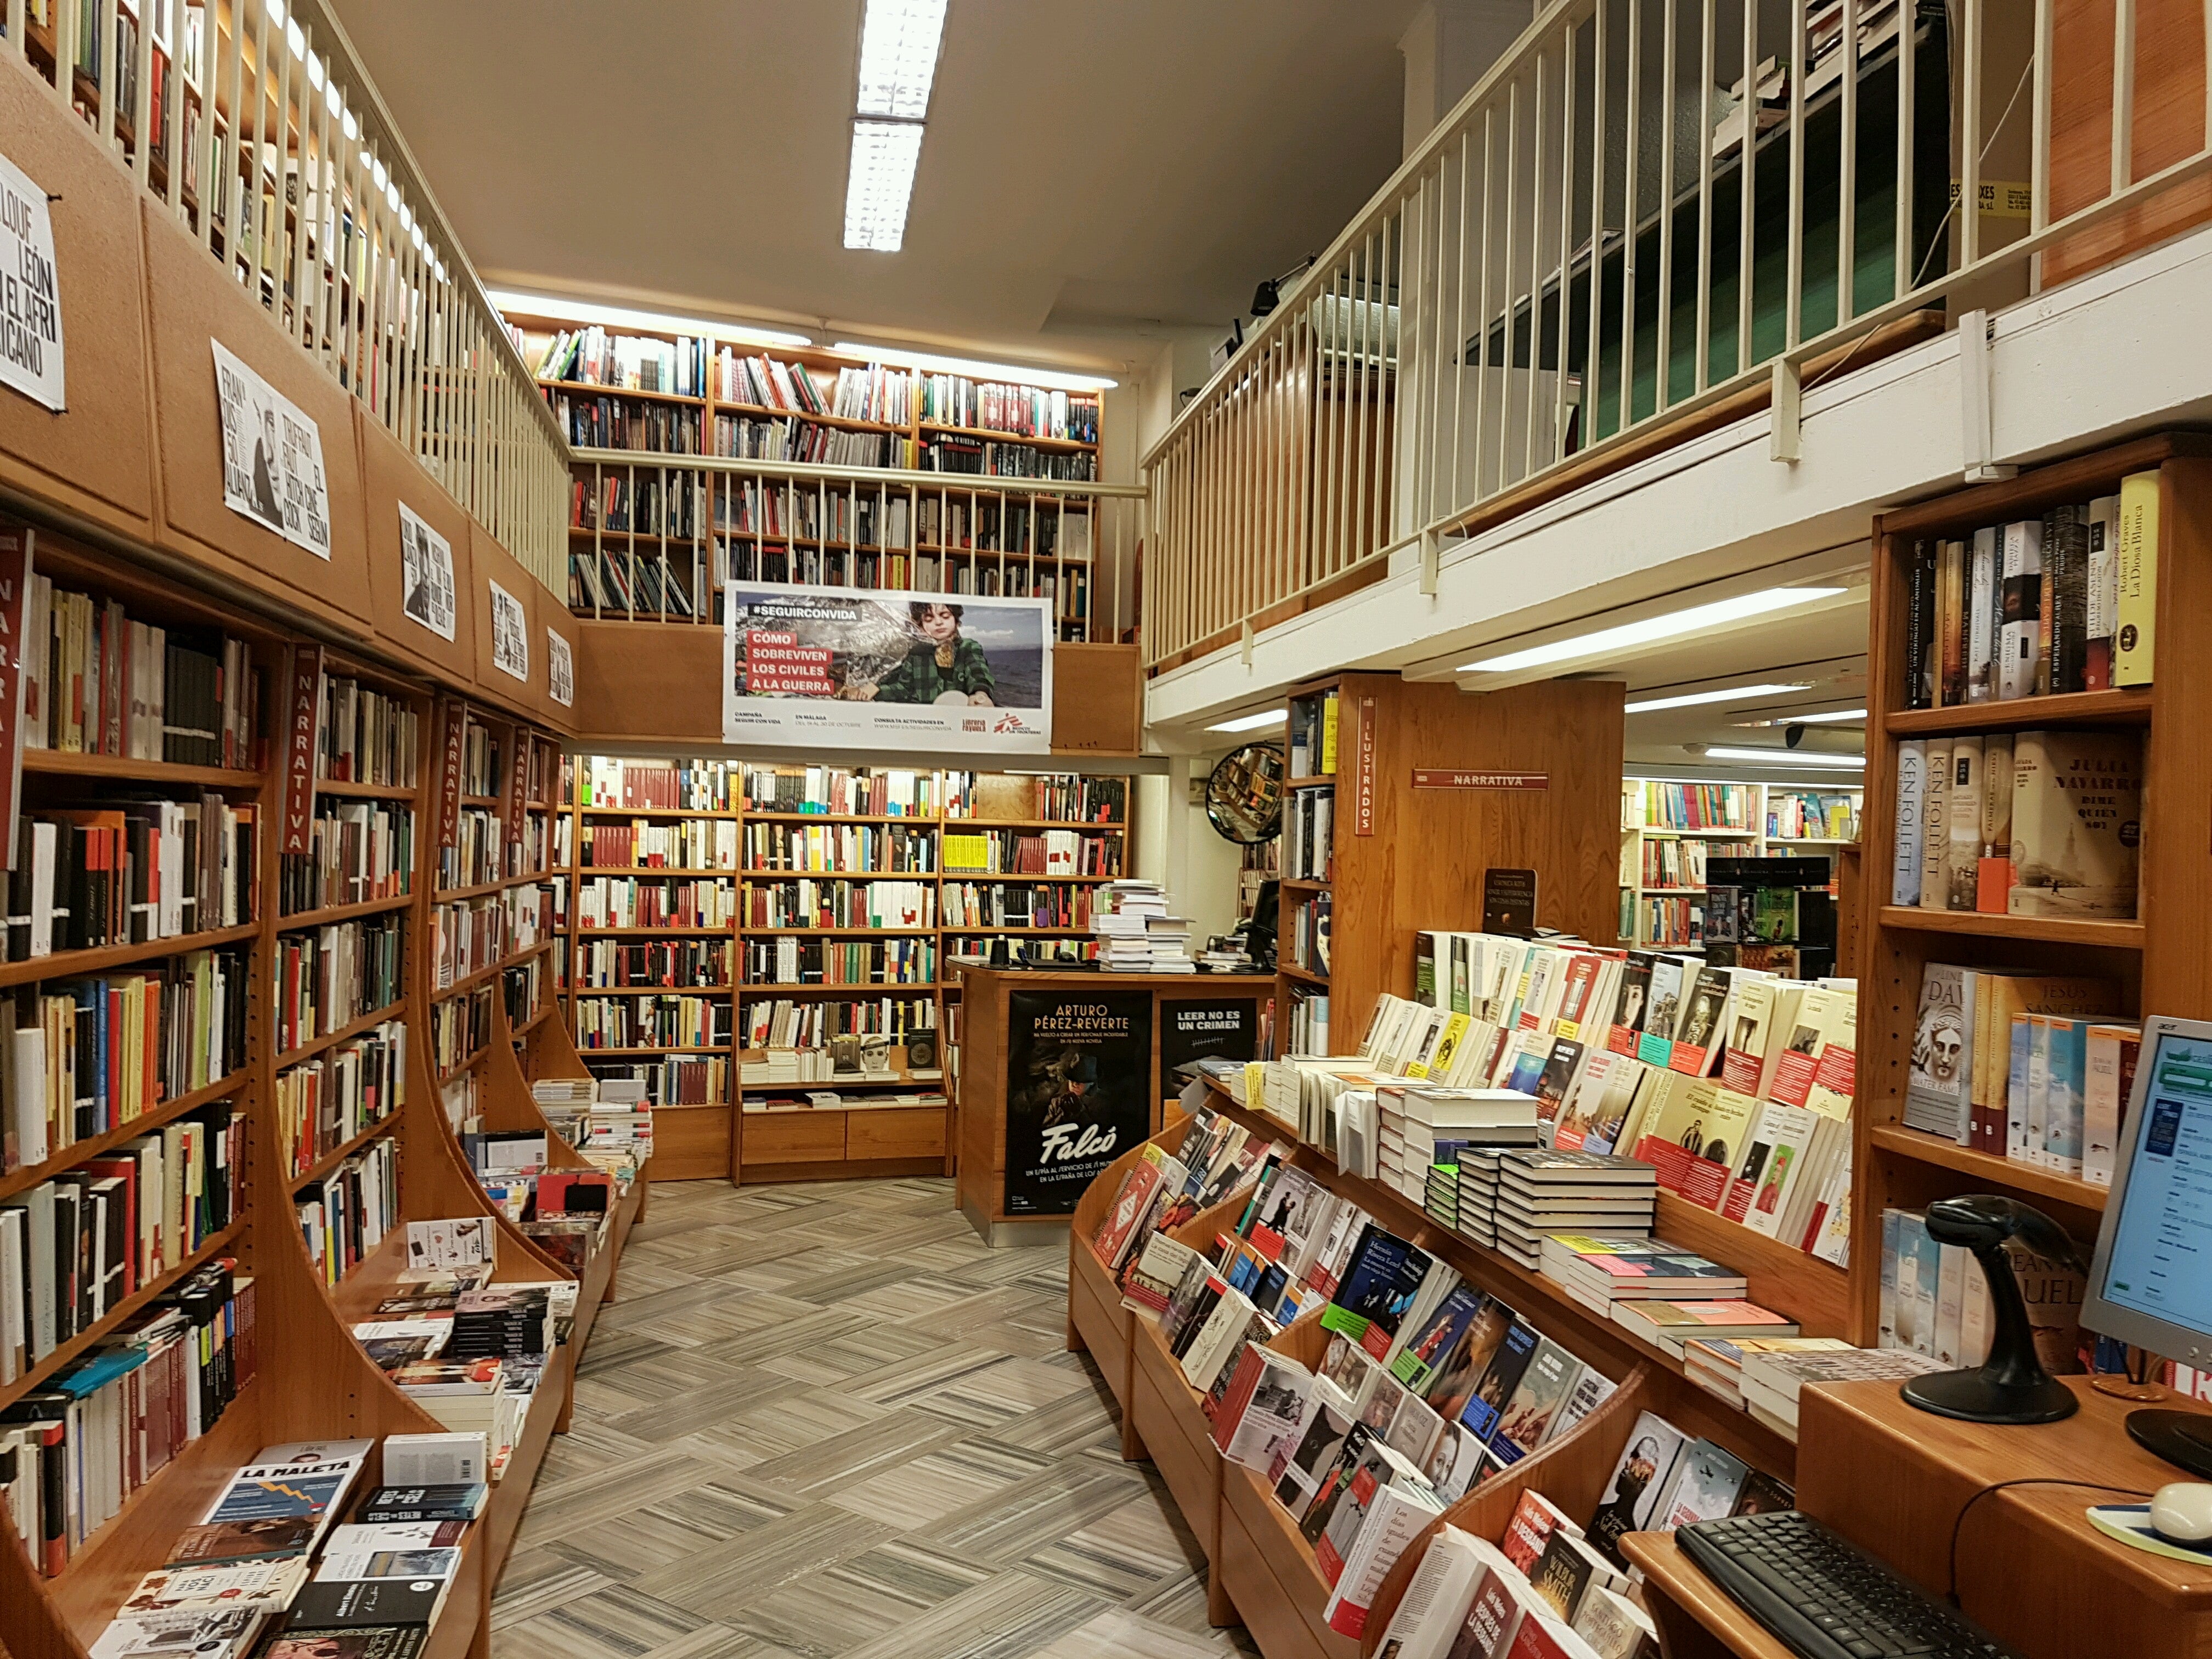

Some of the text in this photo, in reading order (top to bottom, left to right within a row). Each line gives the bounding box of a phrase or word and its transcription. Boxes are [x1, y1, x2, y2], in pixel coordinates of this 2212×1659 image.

[18, 239, 54, 301] LEÓN
[7, 273, 56, 343] EL AFRI
[2119, 515, 2130, 593] Robert Graves
[2130, 504, 2143, 598] La Diosa Blanca
[753, 605, 857, 620] #SEGUIRCONVIDA
[752, 632, 791, 645] CÓMO
[752, 648, 827, 662] SOBREVIVEN
[752, 664, 825, 676] LOS CIVILES
[752, 679, 831, 692] A LA GUERRA
[288, 674, 312, 850] NARRATIVA
[1361, 720, 1372, 828] ILUSTRADOS
[1454, 774, 1523, 787] NARRATIVA
[441, 722, 460, 845] NARRATIVA
[510, 742, 526, 842] NARRATIVA
[1899, 757, 1916, 876] KEN FOLLETT
[1927, 757, 1945, 878] KEN FOLLETT
[1055, 1004, 1108, 1017] ARTURO
[1177, 1011, 1240, 1021] LEER NO ES
[1034, 1015, 1129, 1030] PÉREZ-REVERTE
[1178, 1020, 1240, 1030] UN CRIMEN
[1040, 1123, 1117, 1164] Falcó
[1058, 1164, 1085, 1172] SERVICIO
[1154, 1237, 1171, 1248] Thomas
[240, 1460, 352, 1479] LA MALETA
[1395, 1507, 1408, 1518] Los
[1382, 1537, 1391, 1545] de
[1378, 1547, 1400, 1558] cuand
[1549, 1555, 1576, 1590] WILBUR
[187, 1577, 201, 1592] VOS
[1541, 1569, 1572, 1607] SMITH
[335, 1599, 349, 1617] Albert
[1467, 1612, 1477, 1629] LA
